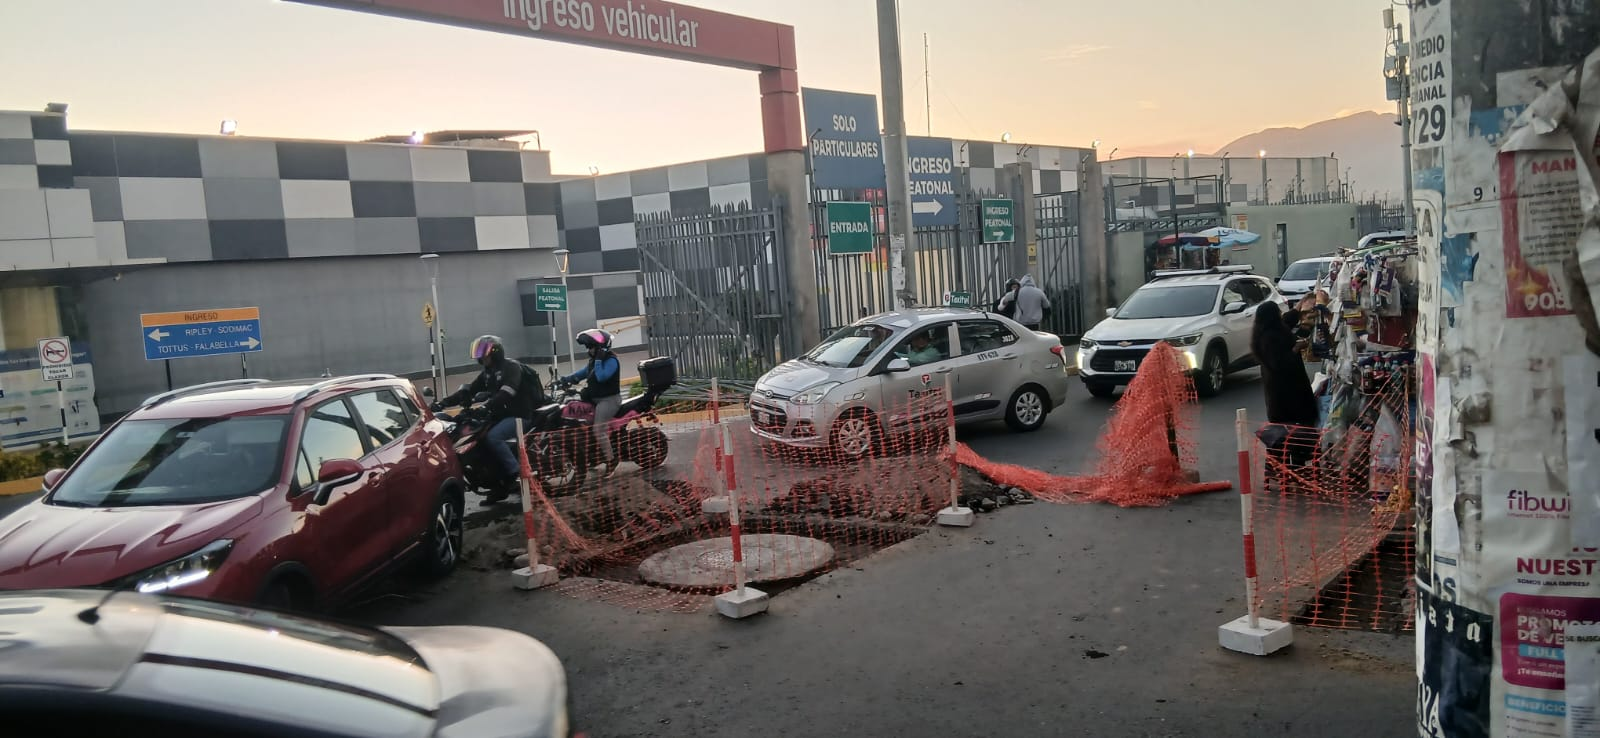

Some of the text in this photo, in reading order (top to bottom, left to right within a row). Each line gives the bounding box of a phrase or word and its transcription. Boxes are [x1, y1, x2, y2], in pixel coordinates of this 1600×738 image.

[601, 0, 699, 47] vehicular
[833, 114, 857, 132] SOLO
[813, 138, 878, 158] PARTICULARES
[909, 156, 951, 174] NGRESO
[909, 180, 954, 195] EATONAL
[830, 221, 869, 234] ENTRADA
[985, 218, 1012, 227] PEATONAL
[184, 311, 219, 321] INGRESO
[185, 324, 254, 337] RIPLEY SODIMAC
[159, 343, 189, 354] TOTTUS
[195, 340, 241, 351] FALABELLA
[1517, 557, 1600, 576] NUEST
[1517, 629, 1539, 643] DE
